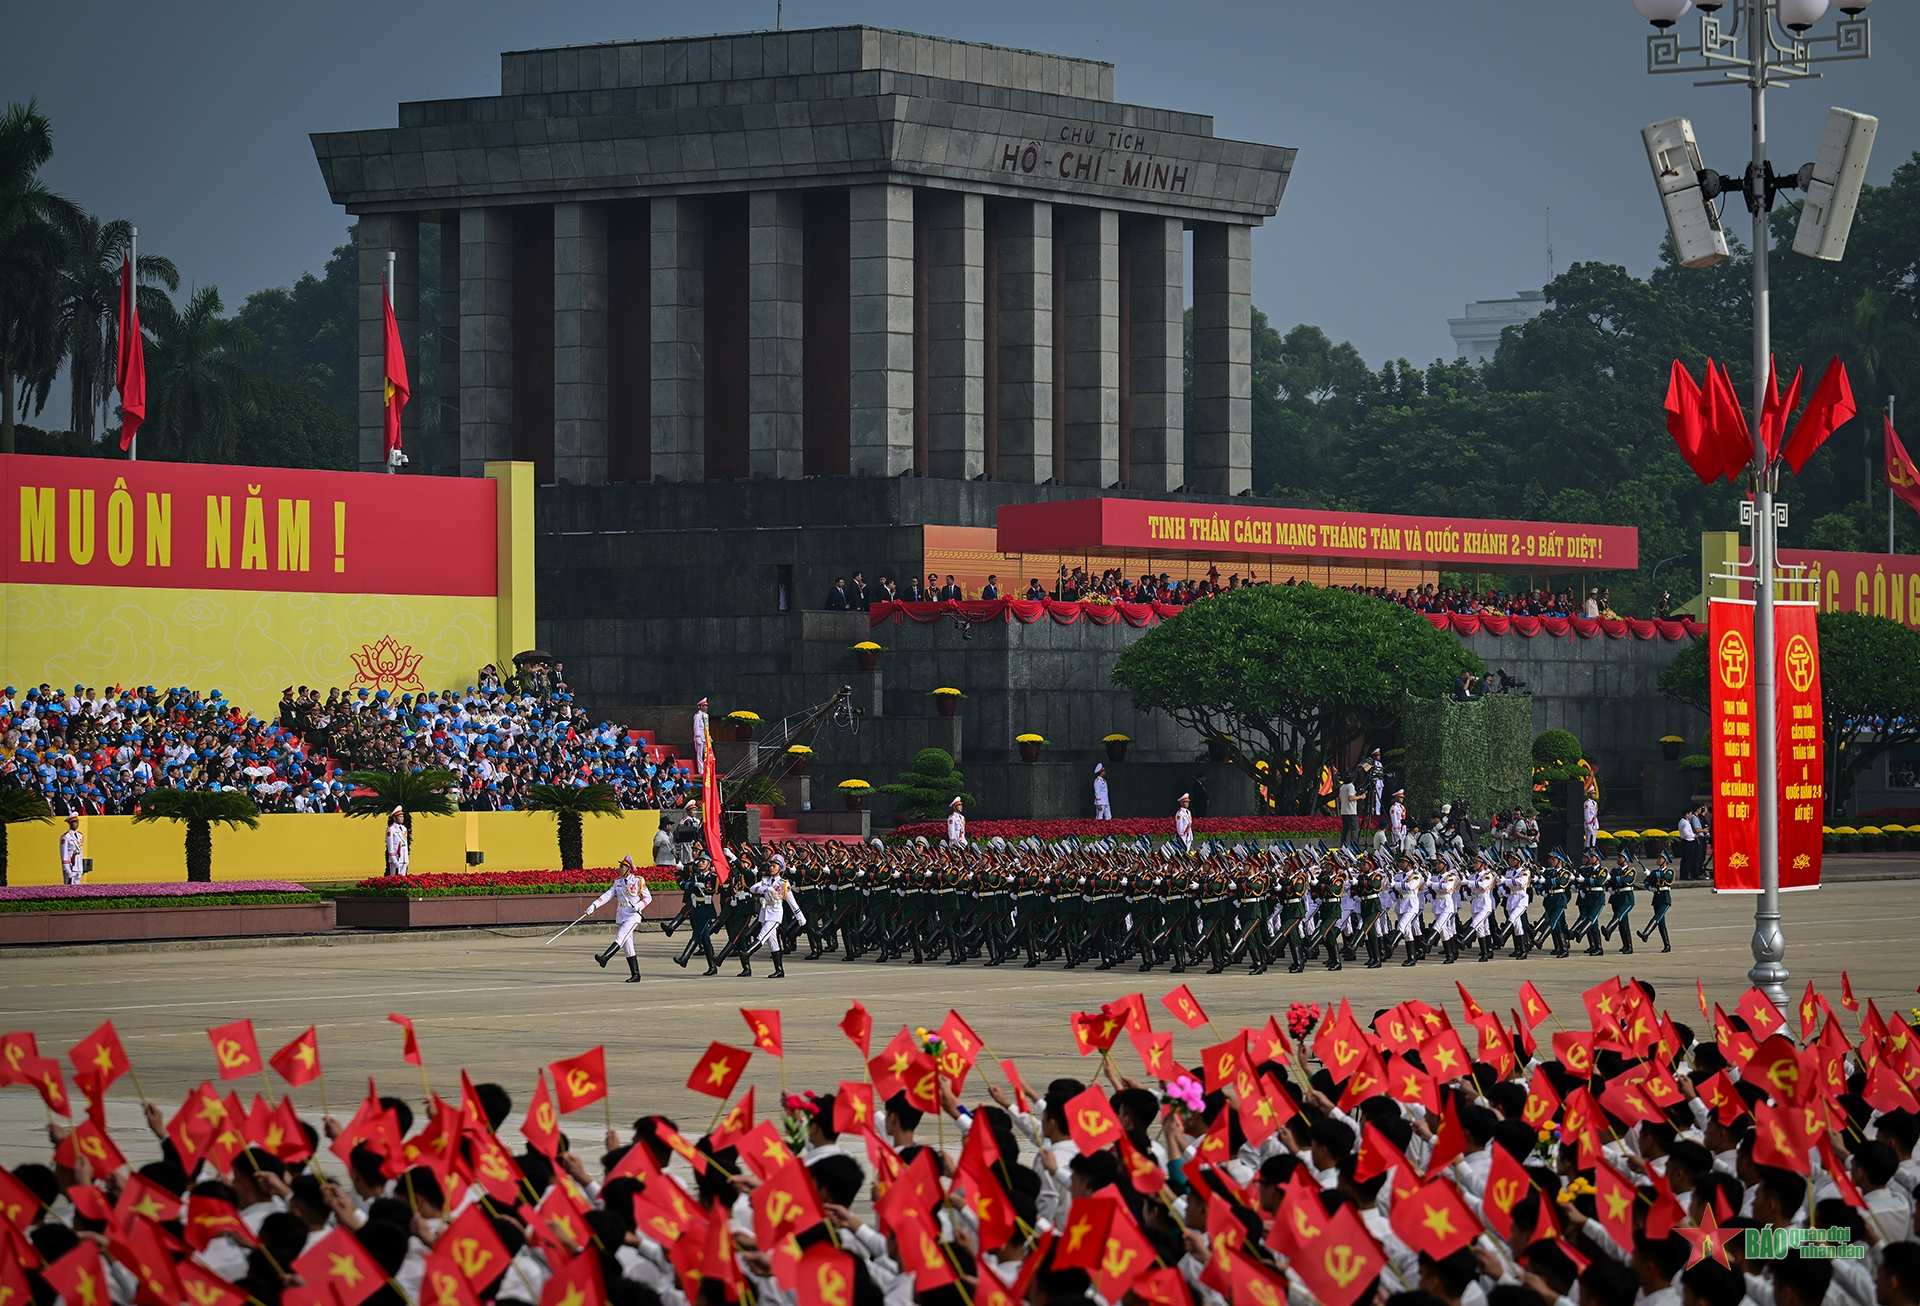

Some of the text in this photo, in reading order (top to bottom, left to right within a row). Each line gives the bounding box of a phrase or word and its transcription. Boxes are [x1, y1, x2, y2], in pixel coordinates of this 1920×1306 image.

[1060, 122, 1095, 144] CHỦ
[1001, 141, 1042, 174] HỒ
[1059, 149, 1106, 182] CHÍ
[20, 477, 171, 567] MUÔN
[206, 484, 310, 572] NĂM
[1148, 515, 1186, 540] TINH
[1190, 511, 1230, 543] THẦN
[1234, 516, 1272, 545] CÁCH
[1276, 522, 1316, 550] MẠNG
[1320, 521, 1367, 549] THÁNG
[1370, 523, 1401, 551] TÁM
[1404, 525, 1422, 551] VÀ
[1425, 524, 1460, 554] QUỐC
[1463, 528, 1508, 555] KHÁNH
[1511, 533, 1535, 557] 2-9
[1538, 530, 1564, 557] BẤT
[1855, 563, 1920, 626] CÔNG
